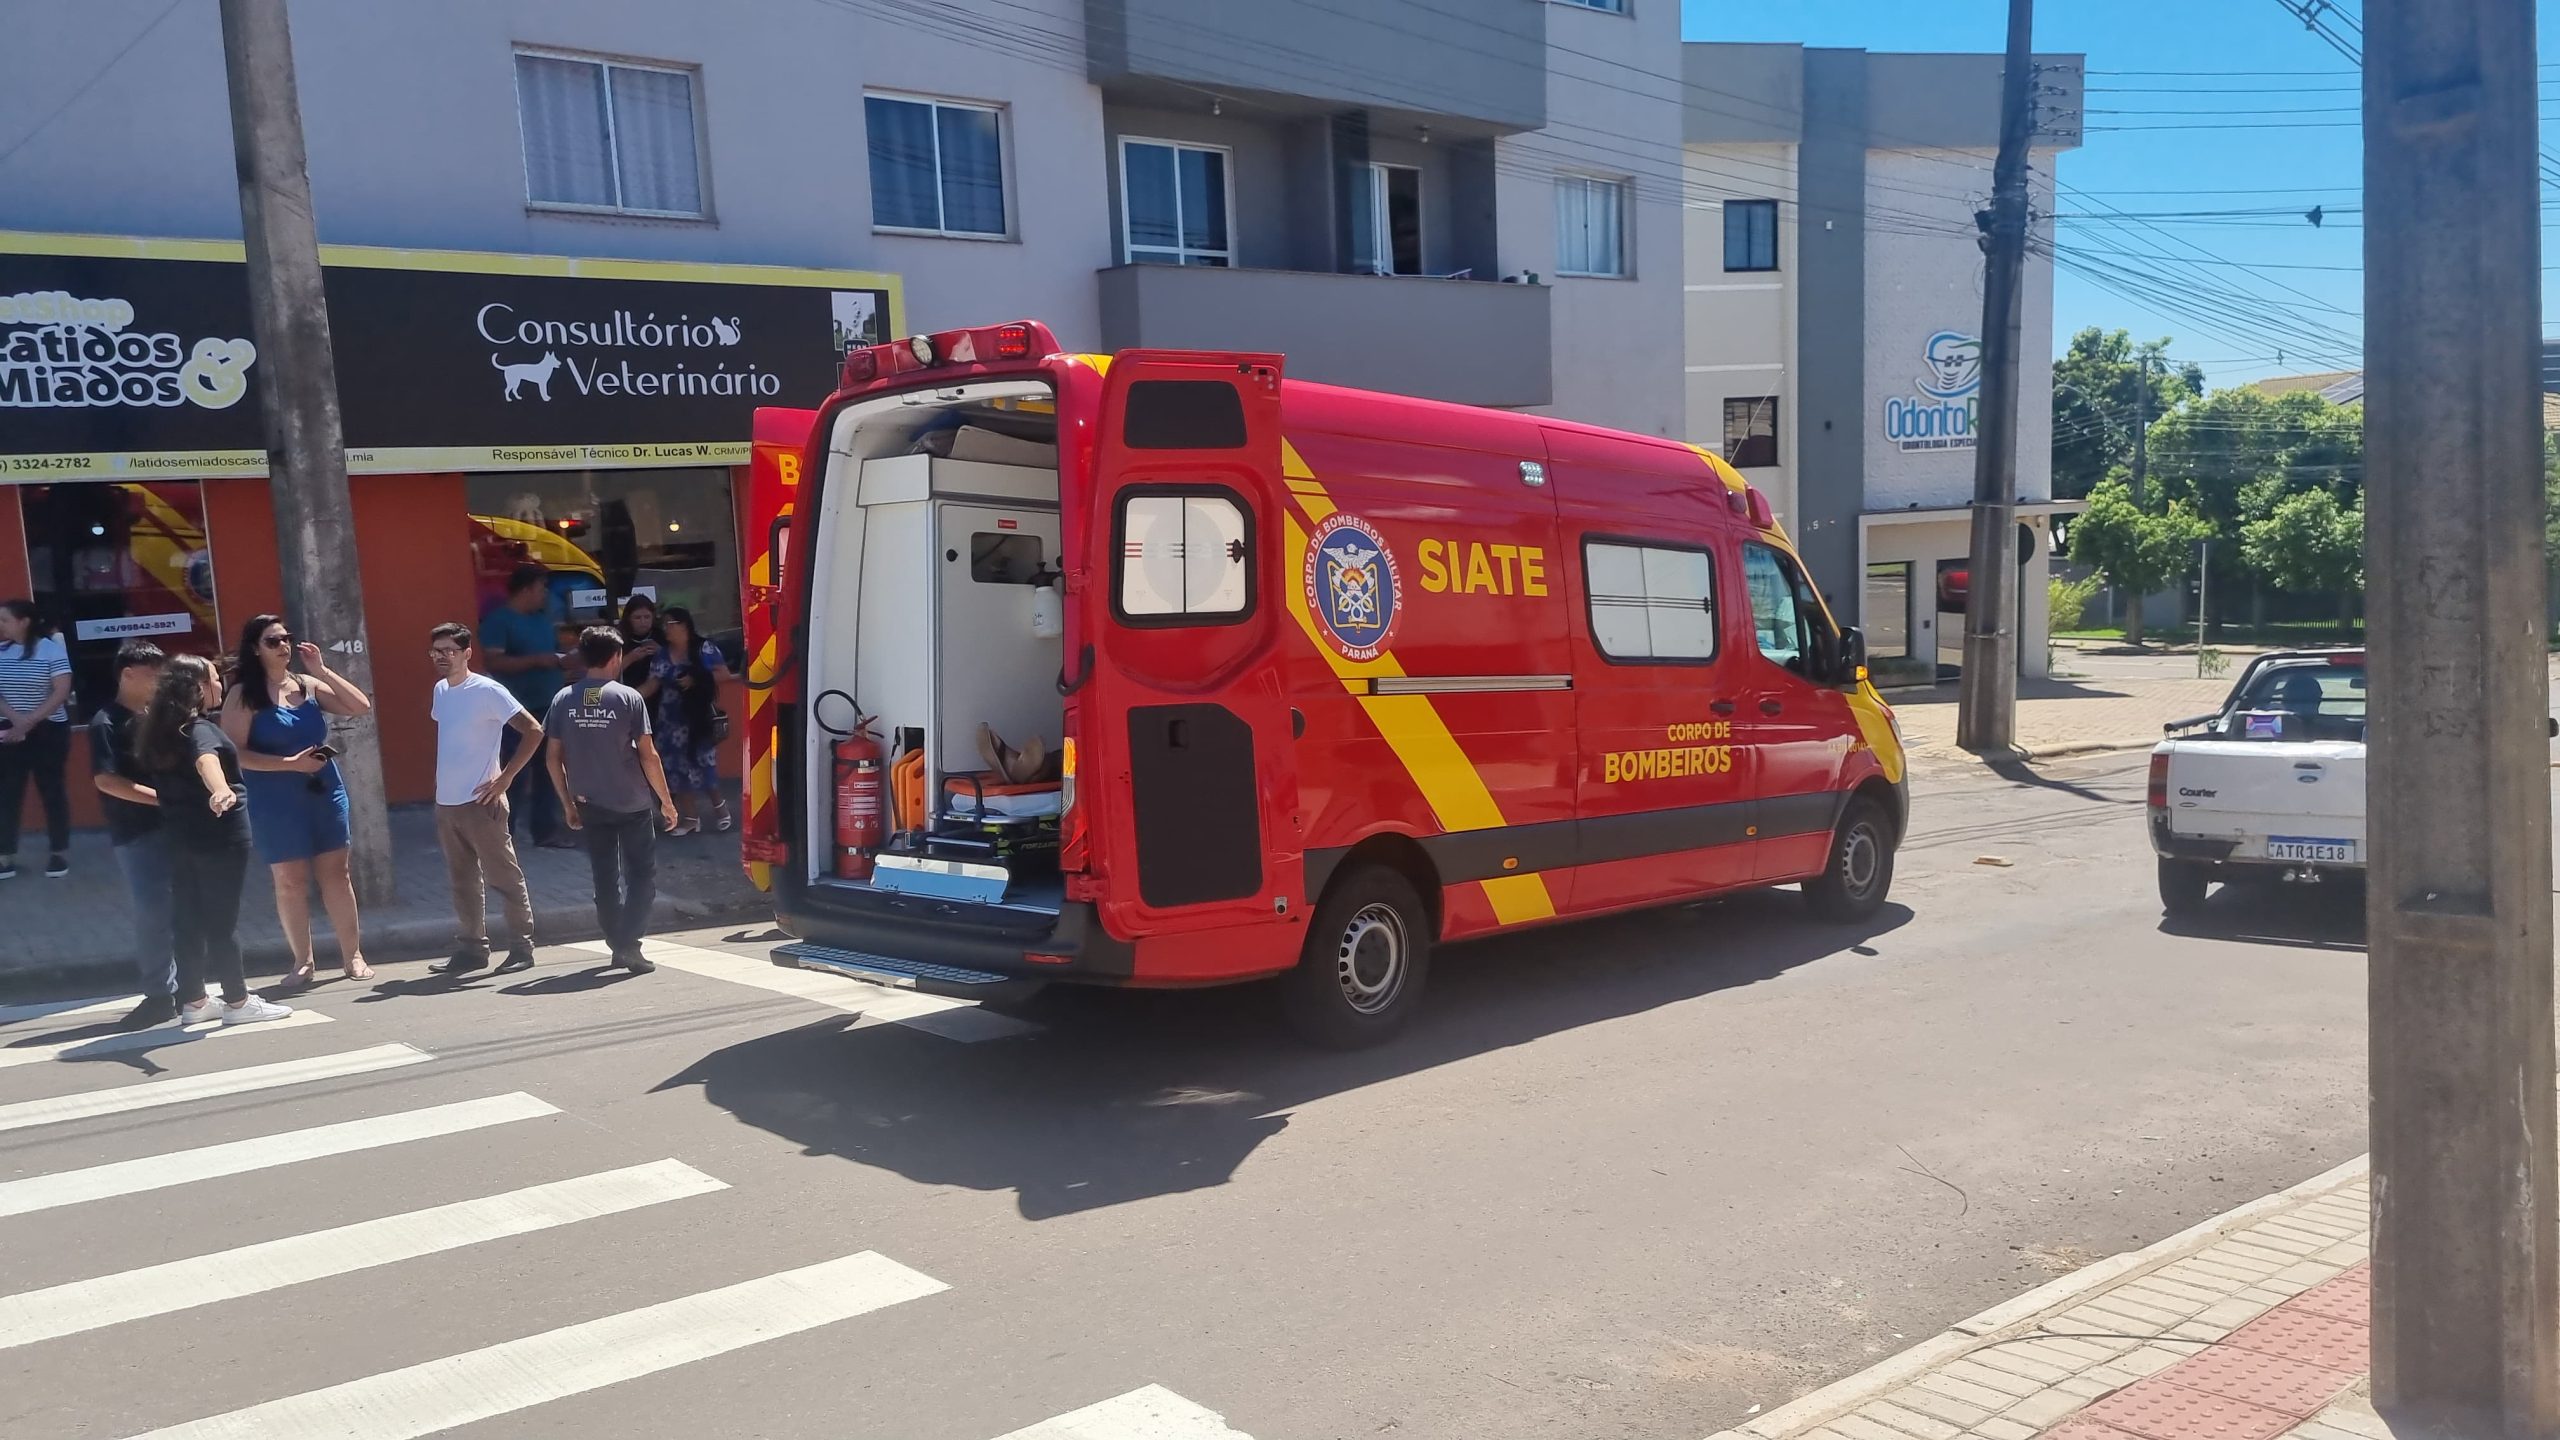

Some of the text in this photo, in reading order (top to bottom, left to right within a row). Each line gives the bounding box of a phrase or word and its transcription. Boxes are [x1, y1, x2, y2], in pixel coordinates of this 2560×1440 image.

[477, 303, 714, 347] Consultório
[0, 325, 180, 363] atidos
[566, 353, 781, 396] Veterinário
[492, 448, 577, 462] Responsável
[580, 446, 630, 459] Técnico
[633, 447, 651, 457] Dr.
[655, 446, 693, 457] Lucas
[696, 445, 711, 455] W.
[13, 458, 91, 470] 3324-2782
[1305, 515, 1402, 611] CORPO DE BOMBEIROS MILITAR
[1418, 538, 1548, 597] SIATE
[345, 640, 363, 654] 18
[1341, 645, 1379, 660] PARANÁ
[568, 708, 617, 720] R. LIMA
[1667, 721, 1731, 742] CORPO DE
[1604, 745, 1732, 783] BOMBEIROS
[2179, 787, 2218, 798] Courier
[2275, 844, 2345, 860] ATR1E18
